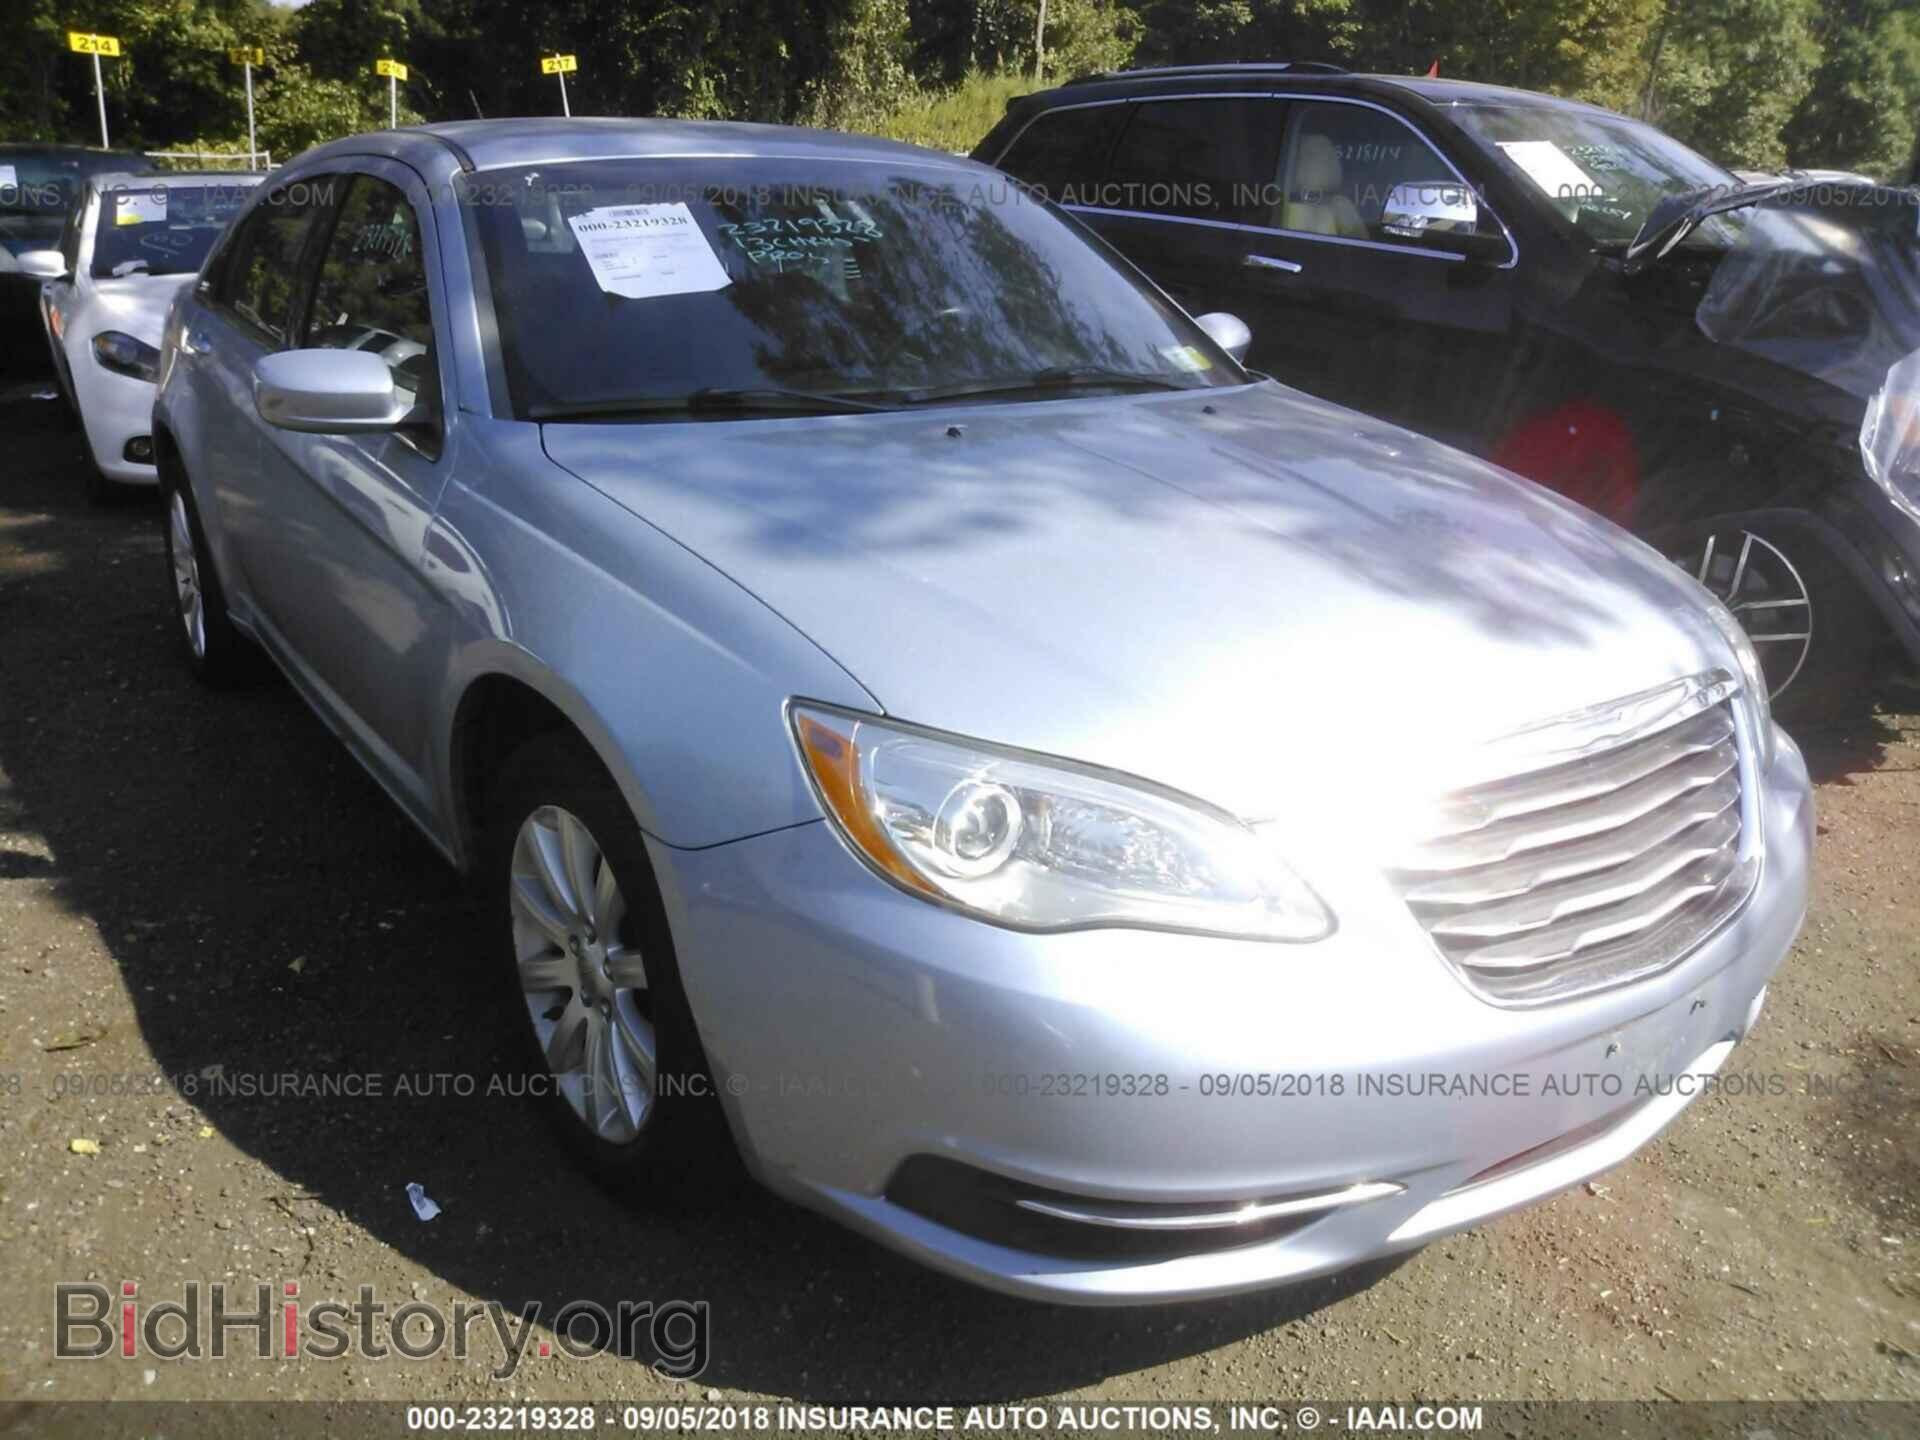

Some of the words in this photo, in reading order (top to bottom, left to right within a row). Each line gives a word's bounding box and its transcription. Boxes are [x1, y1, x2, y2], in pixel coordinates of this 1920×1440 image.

[79, 36, 112, 52] 214
[548, 58, 570, 71] 217
[578, 216, 689, 233] 000-23219328
